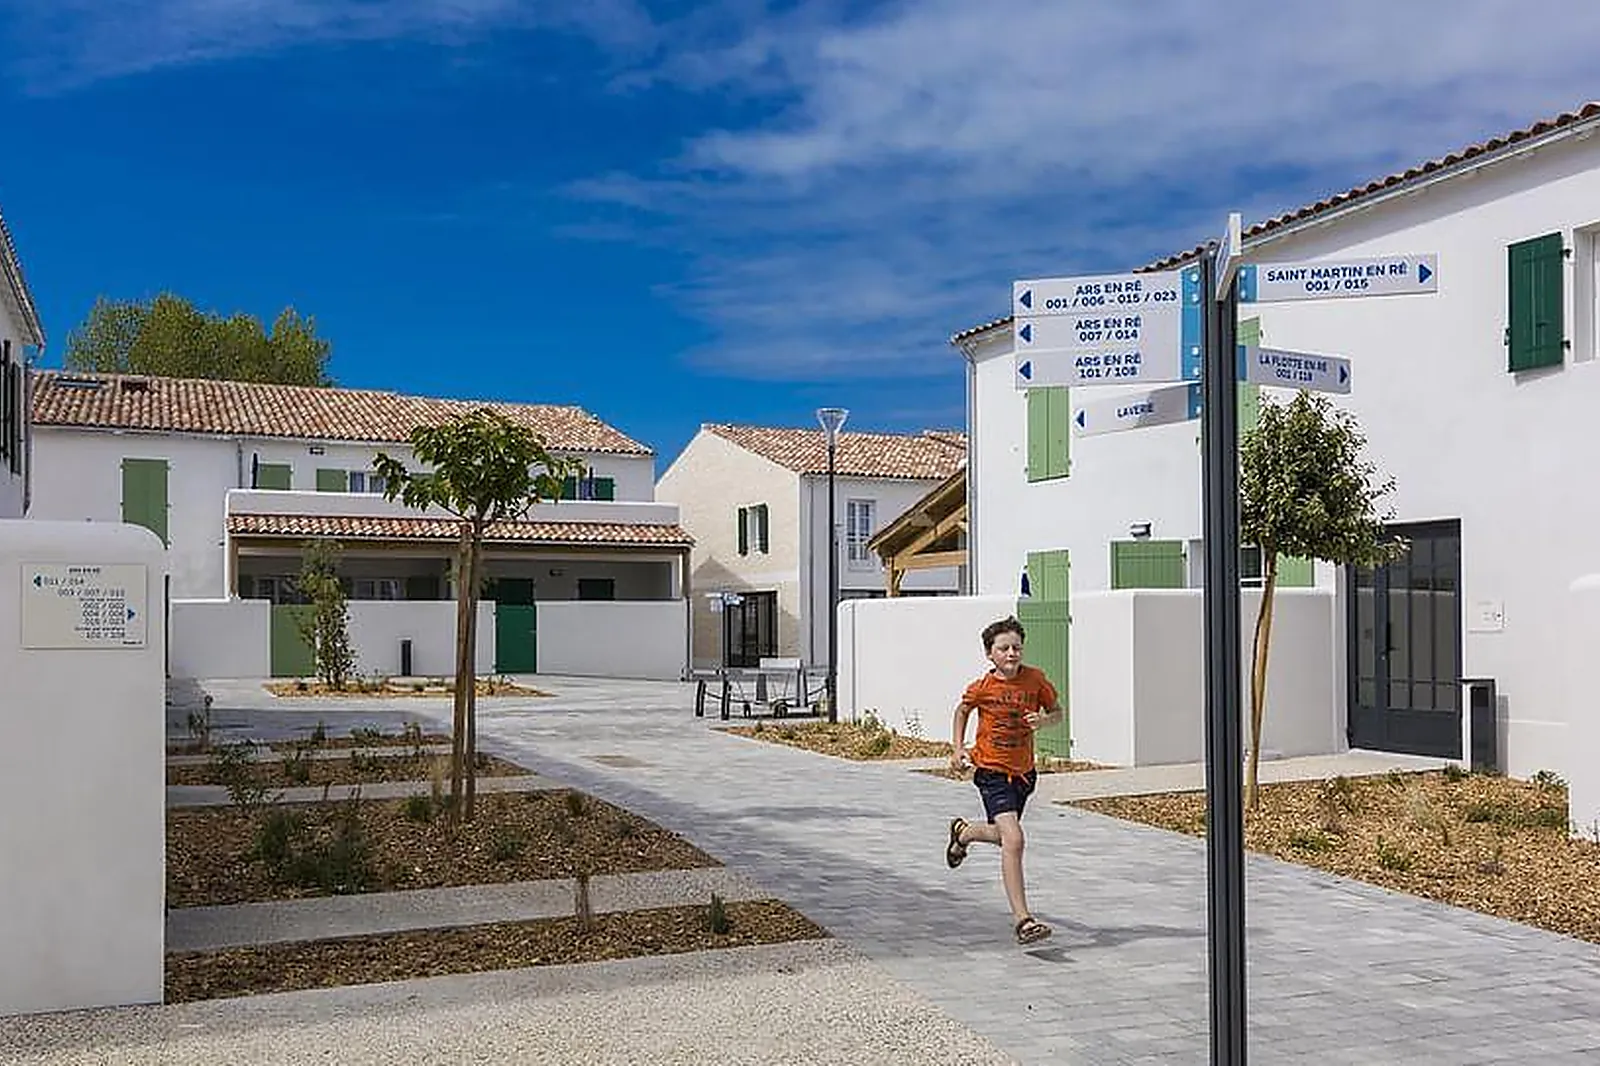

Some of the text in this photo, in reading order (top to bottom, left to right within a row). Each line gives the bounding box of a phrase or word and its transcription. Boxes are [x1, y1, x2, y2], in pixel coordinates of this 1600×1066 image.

[1267, 260, 1407, 282] SAINT MARTIN EN RÉ
[1076, 280, 1142, 296] ARS EN RÉ
[1305, 280, 1330, 292] 001
[1344, 278, 1369, 289] 015
[1046, 298, 1068, 309] 001
[1082, 296, 1105, 307] 006
[1117, 294, 1140, 304] 015
[1154, 290, 1177, 302] 023
[1075, 315, 1141, 330] ARS EN RÉ
[1079, 331, 1102, 342] 007
[1115, 329, 1138, 340] 014
[1075, 356, 1101, 367] ARS
[1104, 354, 1122, 366] EN
[1080, 368, 1101, 379] 101
